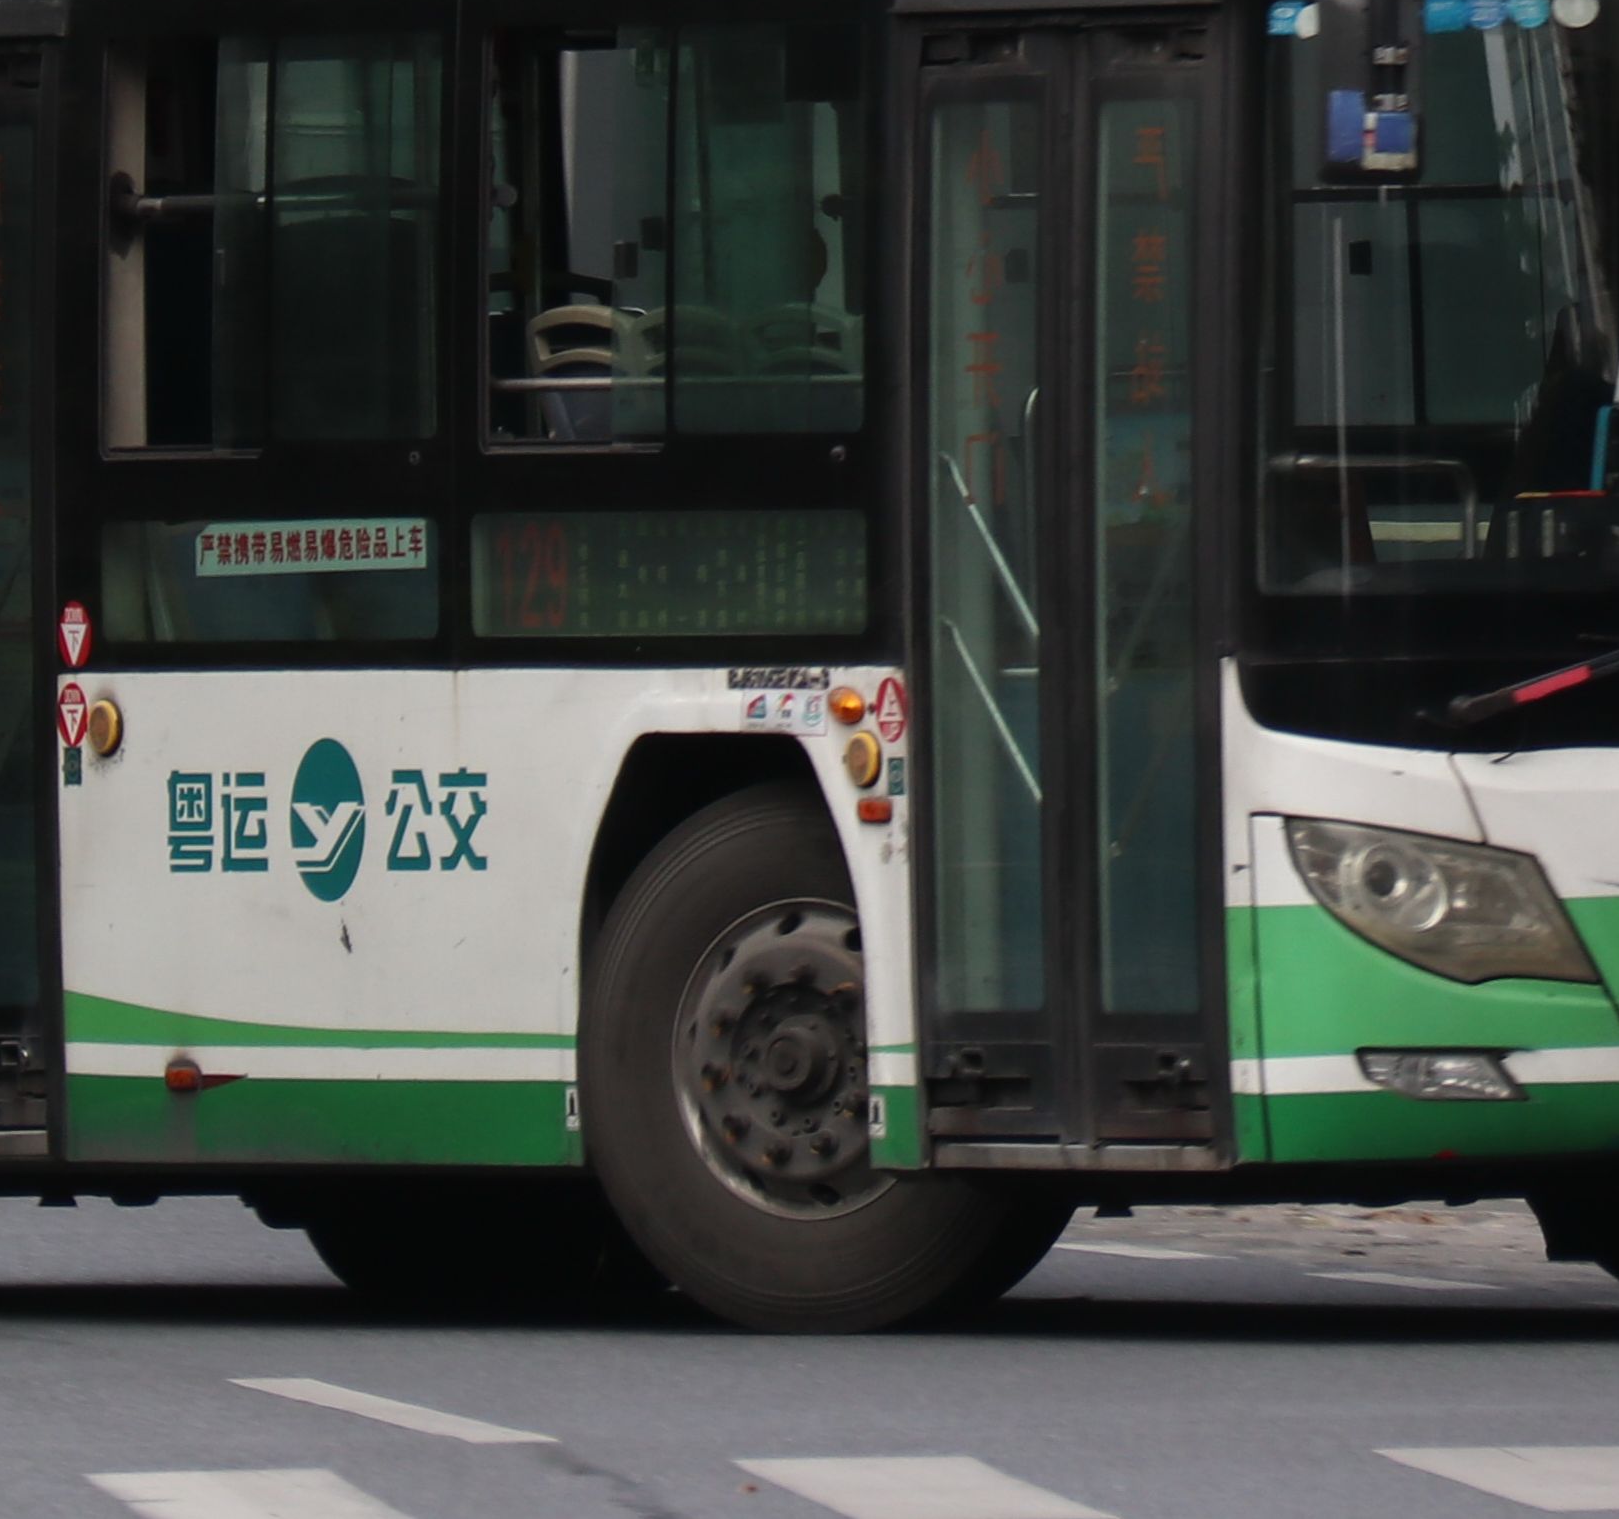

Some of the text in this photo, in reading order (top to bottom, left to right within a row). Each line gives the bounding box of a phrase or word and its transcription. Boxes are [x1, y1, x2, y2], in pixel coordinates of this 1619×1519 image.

[200, 525, 423, 565] 严禁携带易燃易爆危险品上车
[497, 521, 568, 628] 129
[167, 767, 487, 872] 粤运 公交
